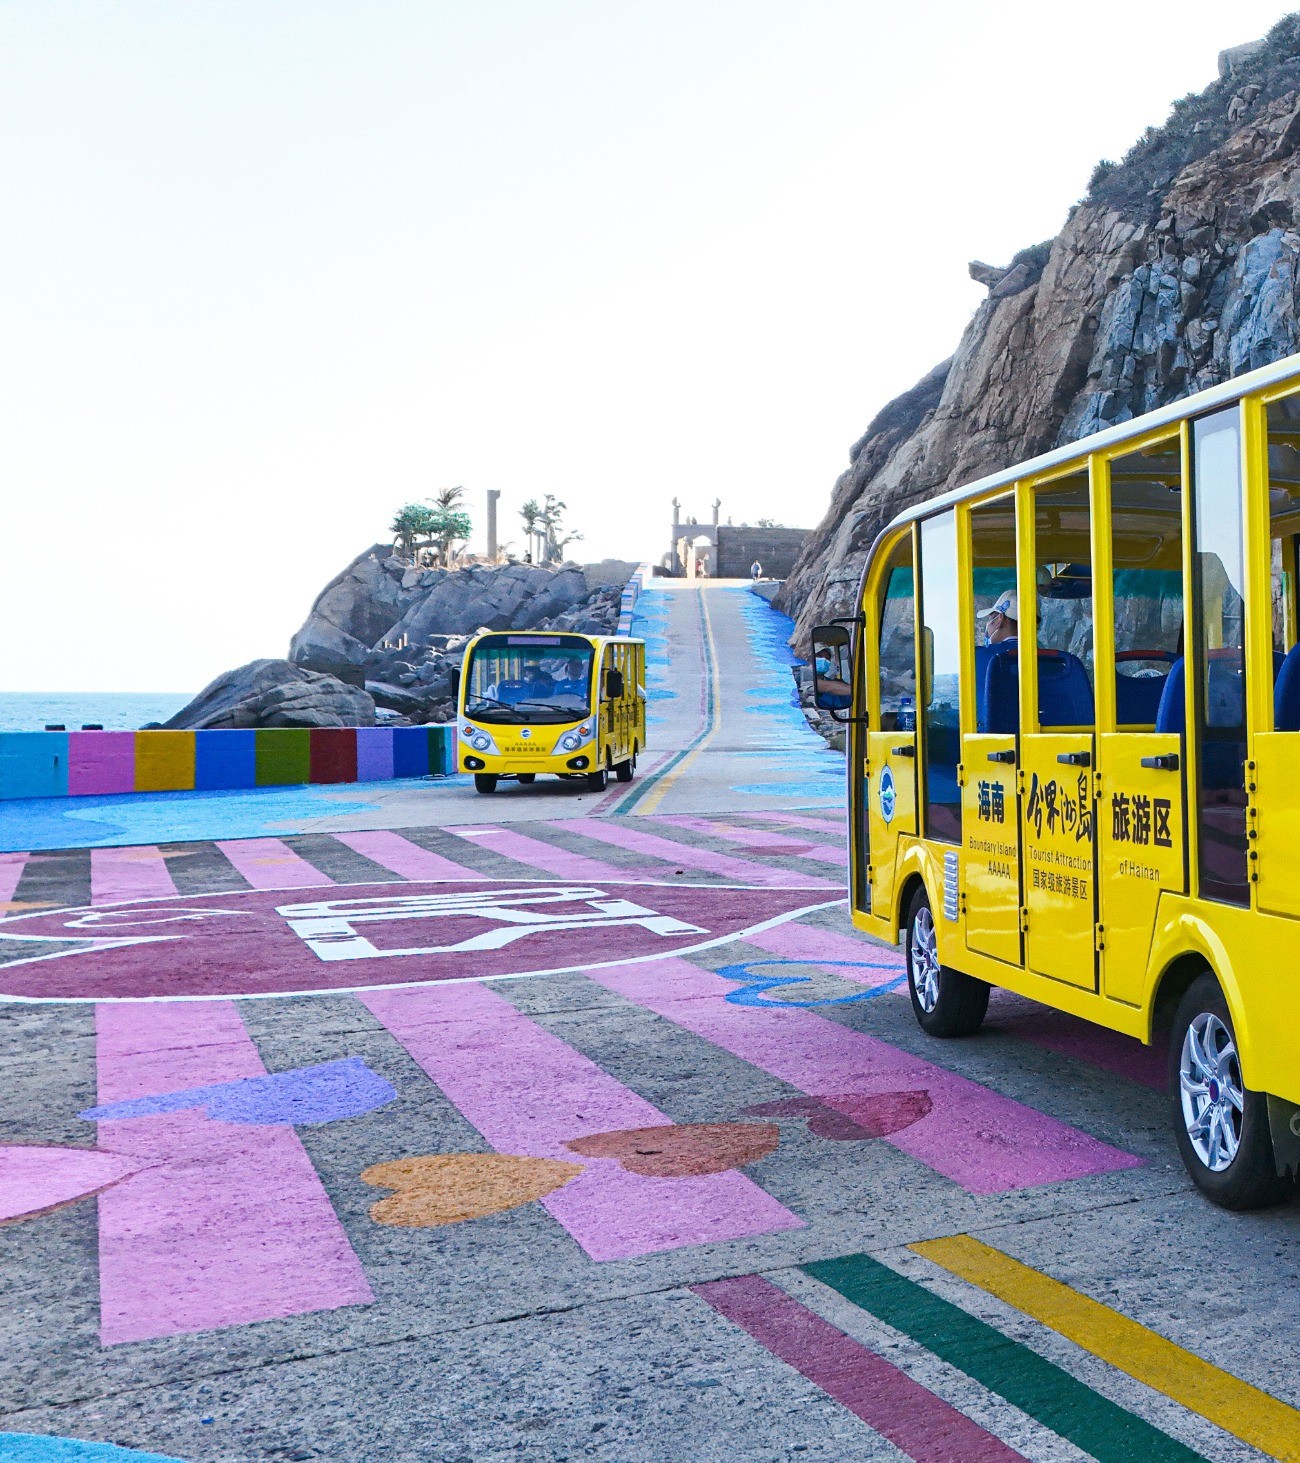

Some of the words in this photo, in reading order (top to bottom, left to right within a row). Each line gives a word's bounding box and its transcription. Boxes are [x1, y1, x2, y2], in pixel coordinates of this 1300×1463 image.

[978, 780, 1005, 824] 海南
[1112, 792, 1172, 847] 旅游区
[969, 836, 997, 855] Boundary
[997, 842, 1016, 858] Island
[1029, 845, 1054, 864] Tourist
[1055, 850, 1092, 871] Attraction
[1120, 860, 1128, 874] of
[1129, 863, 1160, 882] Hainan
[988, 860, 1011, 879] AAAAA
[1033, 868, 1088, 900] 国家级旅游景区
